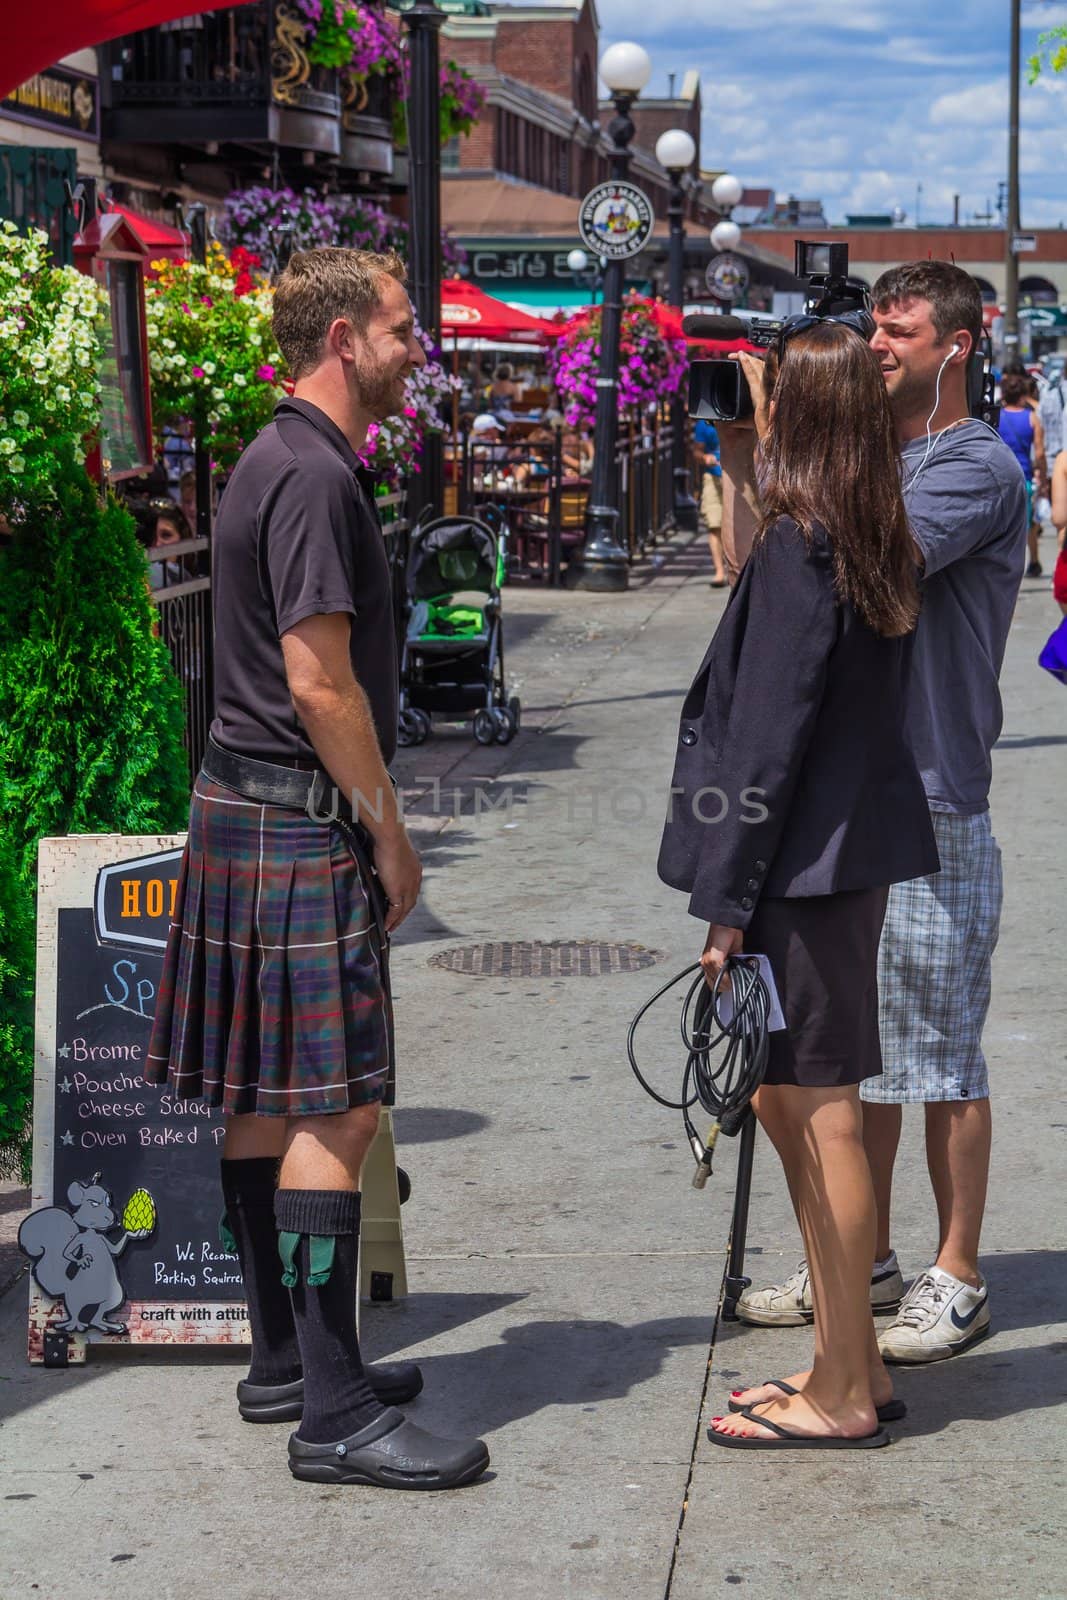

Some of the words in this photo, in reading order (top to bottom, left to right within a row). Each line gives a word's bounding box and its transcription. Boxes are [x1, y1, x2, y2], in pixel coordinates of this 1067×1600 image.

[473, 252, 547, 278] Café
[72, 1037, 142, 1062] Brome
[73, 1071, 158, 1094] Poache
[81, 1130, 127, 1149] Oven
[175, 1241, 195, 1261] We
[154, 1261, 196, 1287] Barking
[140, 1307, 175, 1321] craft
[180, 1307, 211, 1321] with
